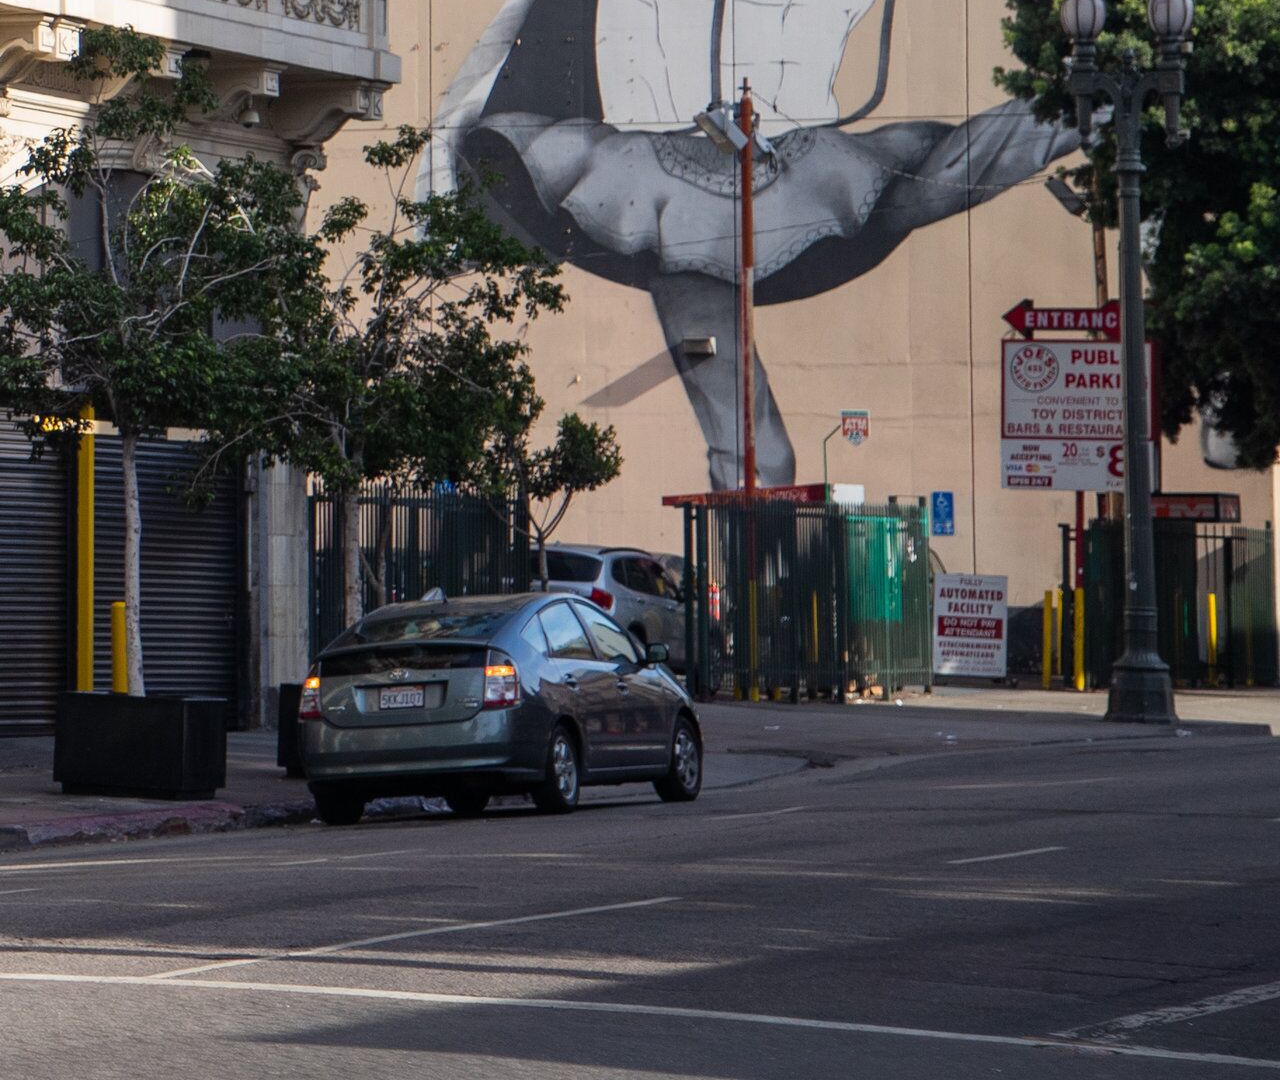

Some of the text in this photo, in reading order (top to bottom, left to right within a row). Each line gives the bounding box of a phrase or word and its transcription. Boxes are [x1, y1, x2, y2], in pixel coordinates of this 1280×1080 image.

[1024, 311, 1117, 328] ENTRANC
[1071, 349, 1119, 364] PUBL
[1064, 372, 1120, 388] PARKI
[1037, 396, 1119, 406] CONVENIENT TO
[1032, 408, 1056, 420] TOY
[1007, 422, 1124, 435] BARS & RESTAURA
[1062, 443, 1078, 458] 20
[1151, 503, 1214, 518] TM
[940, 588, 1003, 601] AUTOMATED
[948, 602, 994, 614] FACILITY
[943, 618, 957, 626] DO
[960, 618, 978, 628] NOT
[944, 627, 996, 638] ATTENDANT
